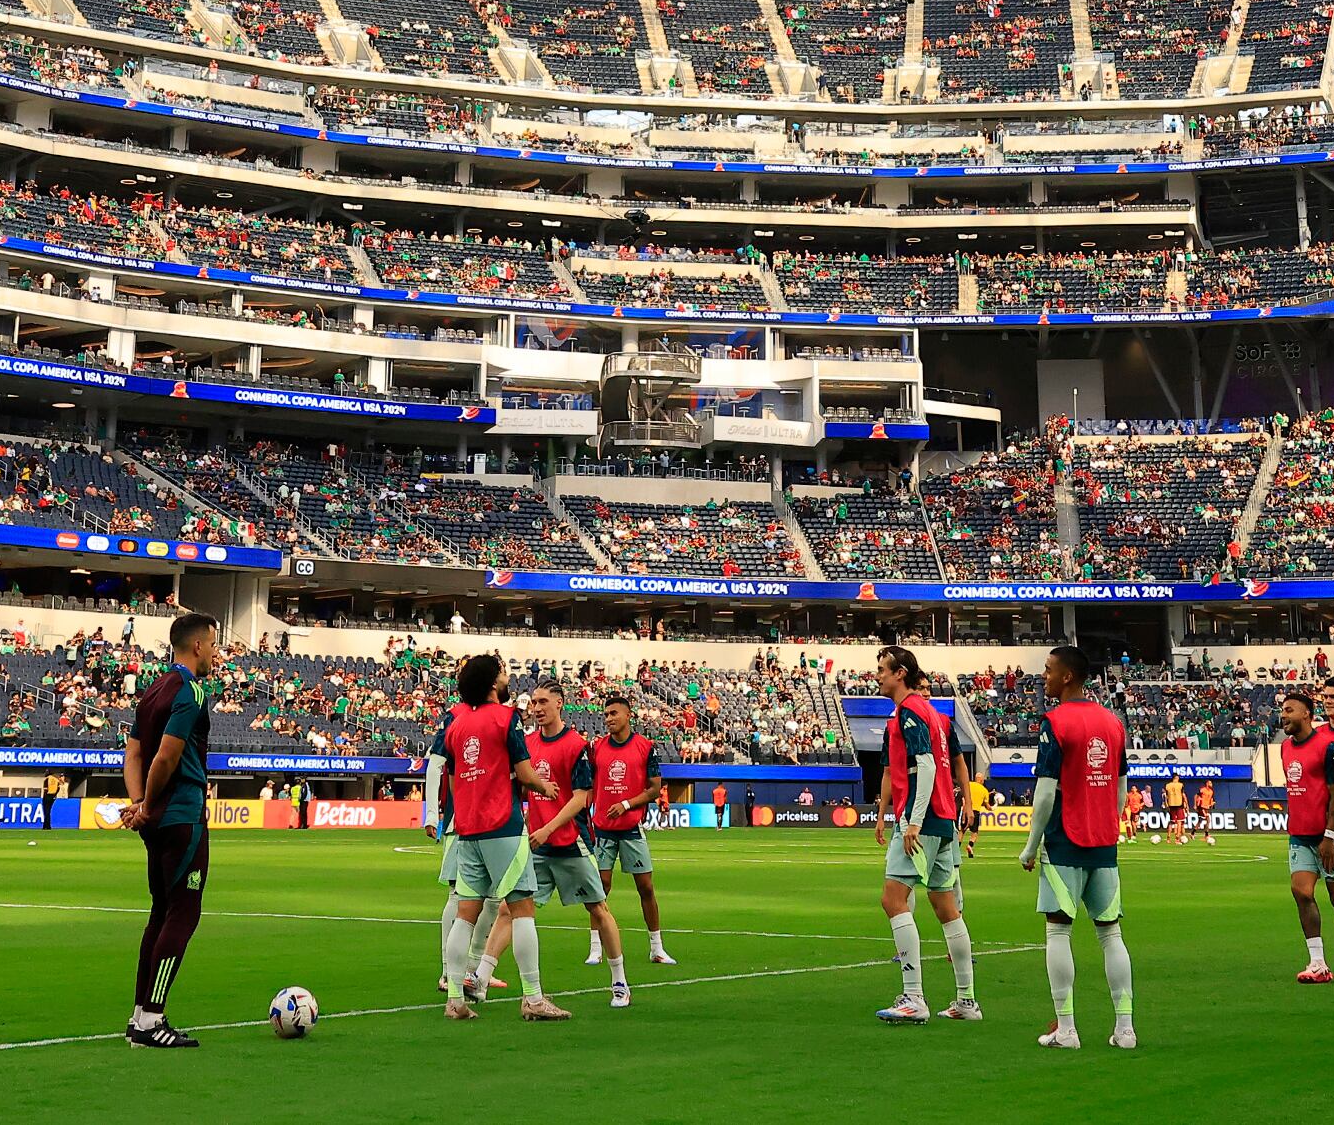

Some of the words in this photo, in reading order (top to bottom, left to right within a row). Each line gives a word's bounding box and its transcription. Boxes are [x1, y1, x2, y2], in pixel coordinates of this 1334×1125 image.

[12, 361, 40, 375] COPA
[39, 365, 83, 381] AMERICA
[83, 371, 103, 384] USA
[103, 374, 126, 387] 2024
[235, 389, 292, 405] CONMEBOL
[291, 395, 319, 408] COPA
[318, 398, 362, 412] AMERICA
[363, 401, 382, 414] USA
[382, 404, 406, 416] 2024
[298, 562, 313, 574] CC
[569, 576, 640, 591] CONMEBOL
[639, 579, 674, 593] COPA
[673, 580, 729, 594] AMERICA
[730, 582, 756, 595] USA
[756, 582, 790, 595] 2024
[943, 586, 1017, 599] CONMEBOL
[1017, 586, 1054, 599] COPA
[1053, 586, 1113, 599] AMERICA
[1114, 585, 1141, 599] USA
[1141, 585, 1173, 598] 2024
[17, 751, 43, 763] COPA
[42, 752, 84, 764] AMERICA
[84, 752, 102, 765] USA
[102, 753, 124, 765] 2024
[227, 756, 274, 768] CONMEBOL
[273, 757, 295, 769] COPA
[294, 758, 331, 770] AMERICA
[330, 759, 346, 770] USA
[346, 759, 365, 770] 2024
[1126, 765, 1169, 777] MERICA
[1195, 765, 1223, 777] 2024
[214, 804, 250, 824] libre
[314, 801, 376, 826] Betano
[775, 810, 819, 825] priceless
